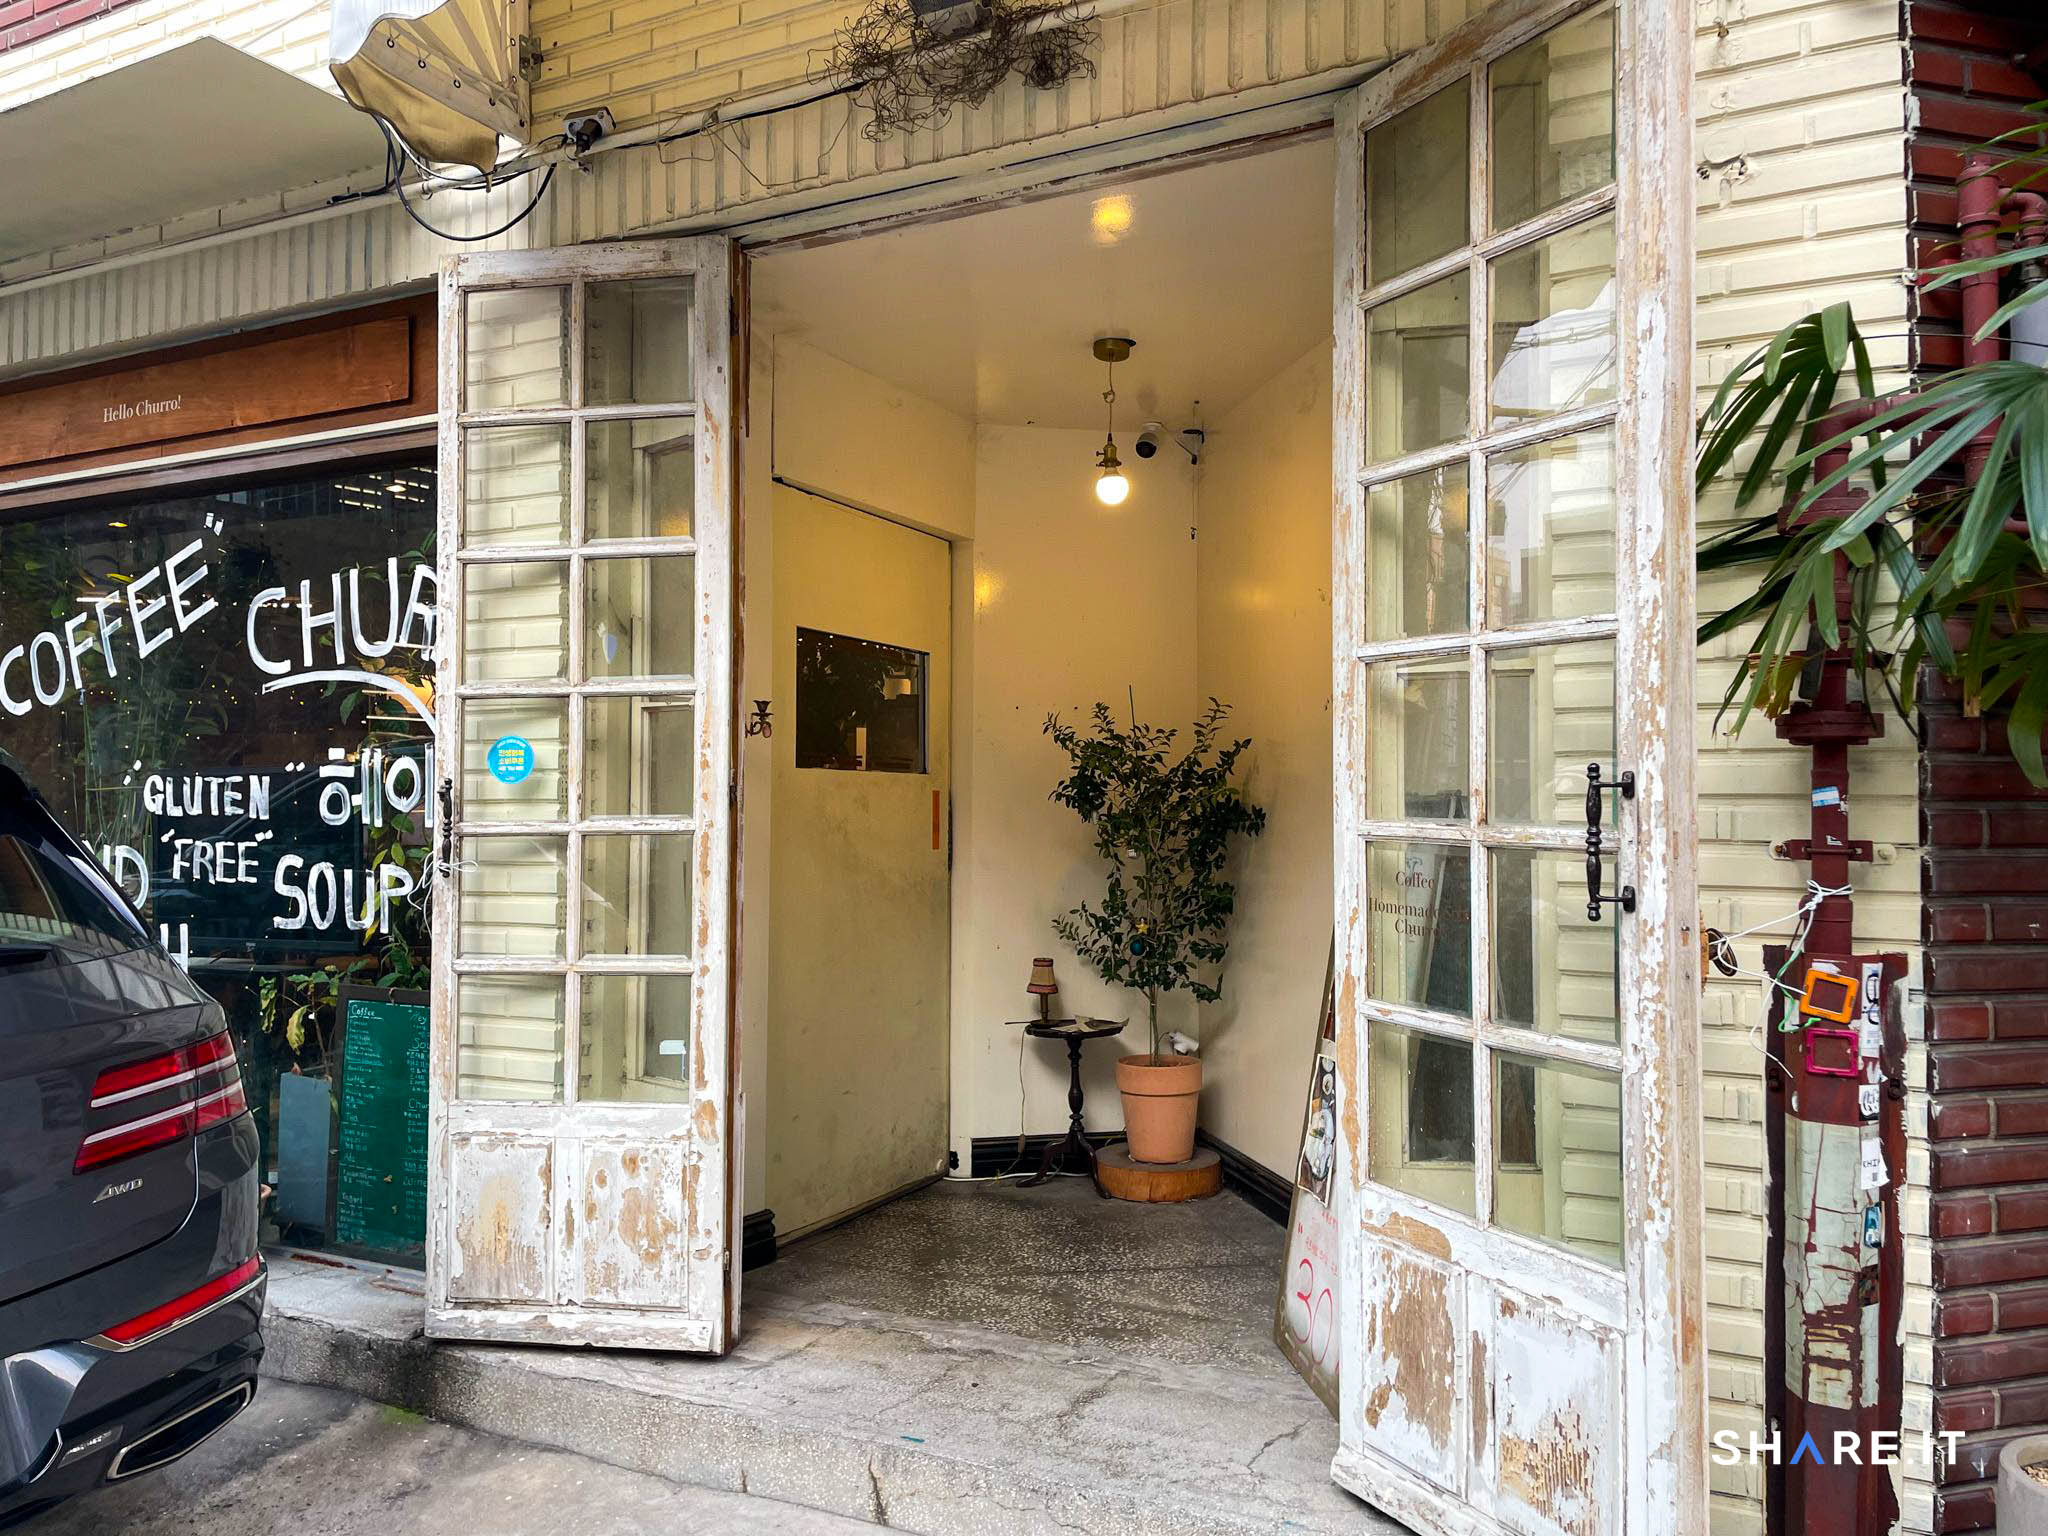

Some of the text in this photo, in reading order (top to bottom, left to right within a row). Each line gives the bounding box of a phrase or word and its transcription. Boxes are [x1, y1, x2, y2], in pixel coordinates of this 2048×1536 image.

[103, 394, 181, 423] Hello Churro!
[273, 853, 414, 934] SOUP
[1395, 871, 1436, 889] Coffee
